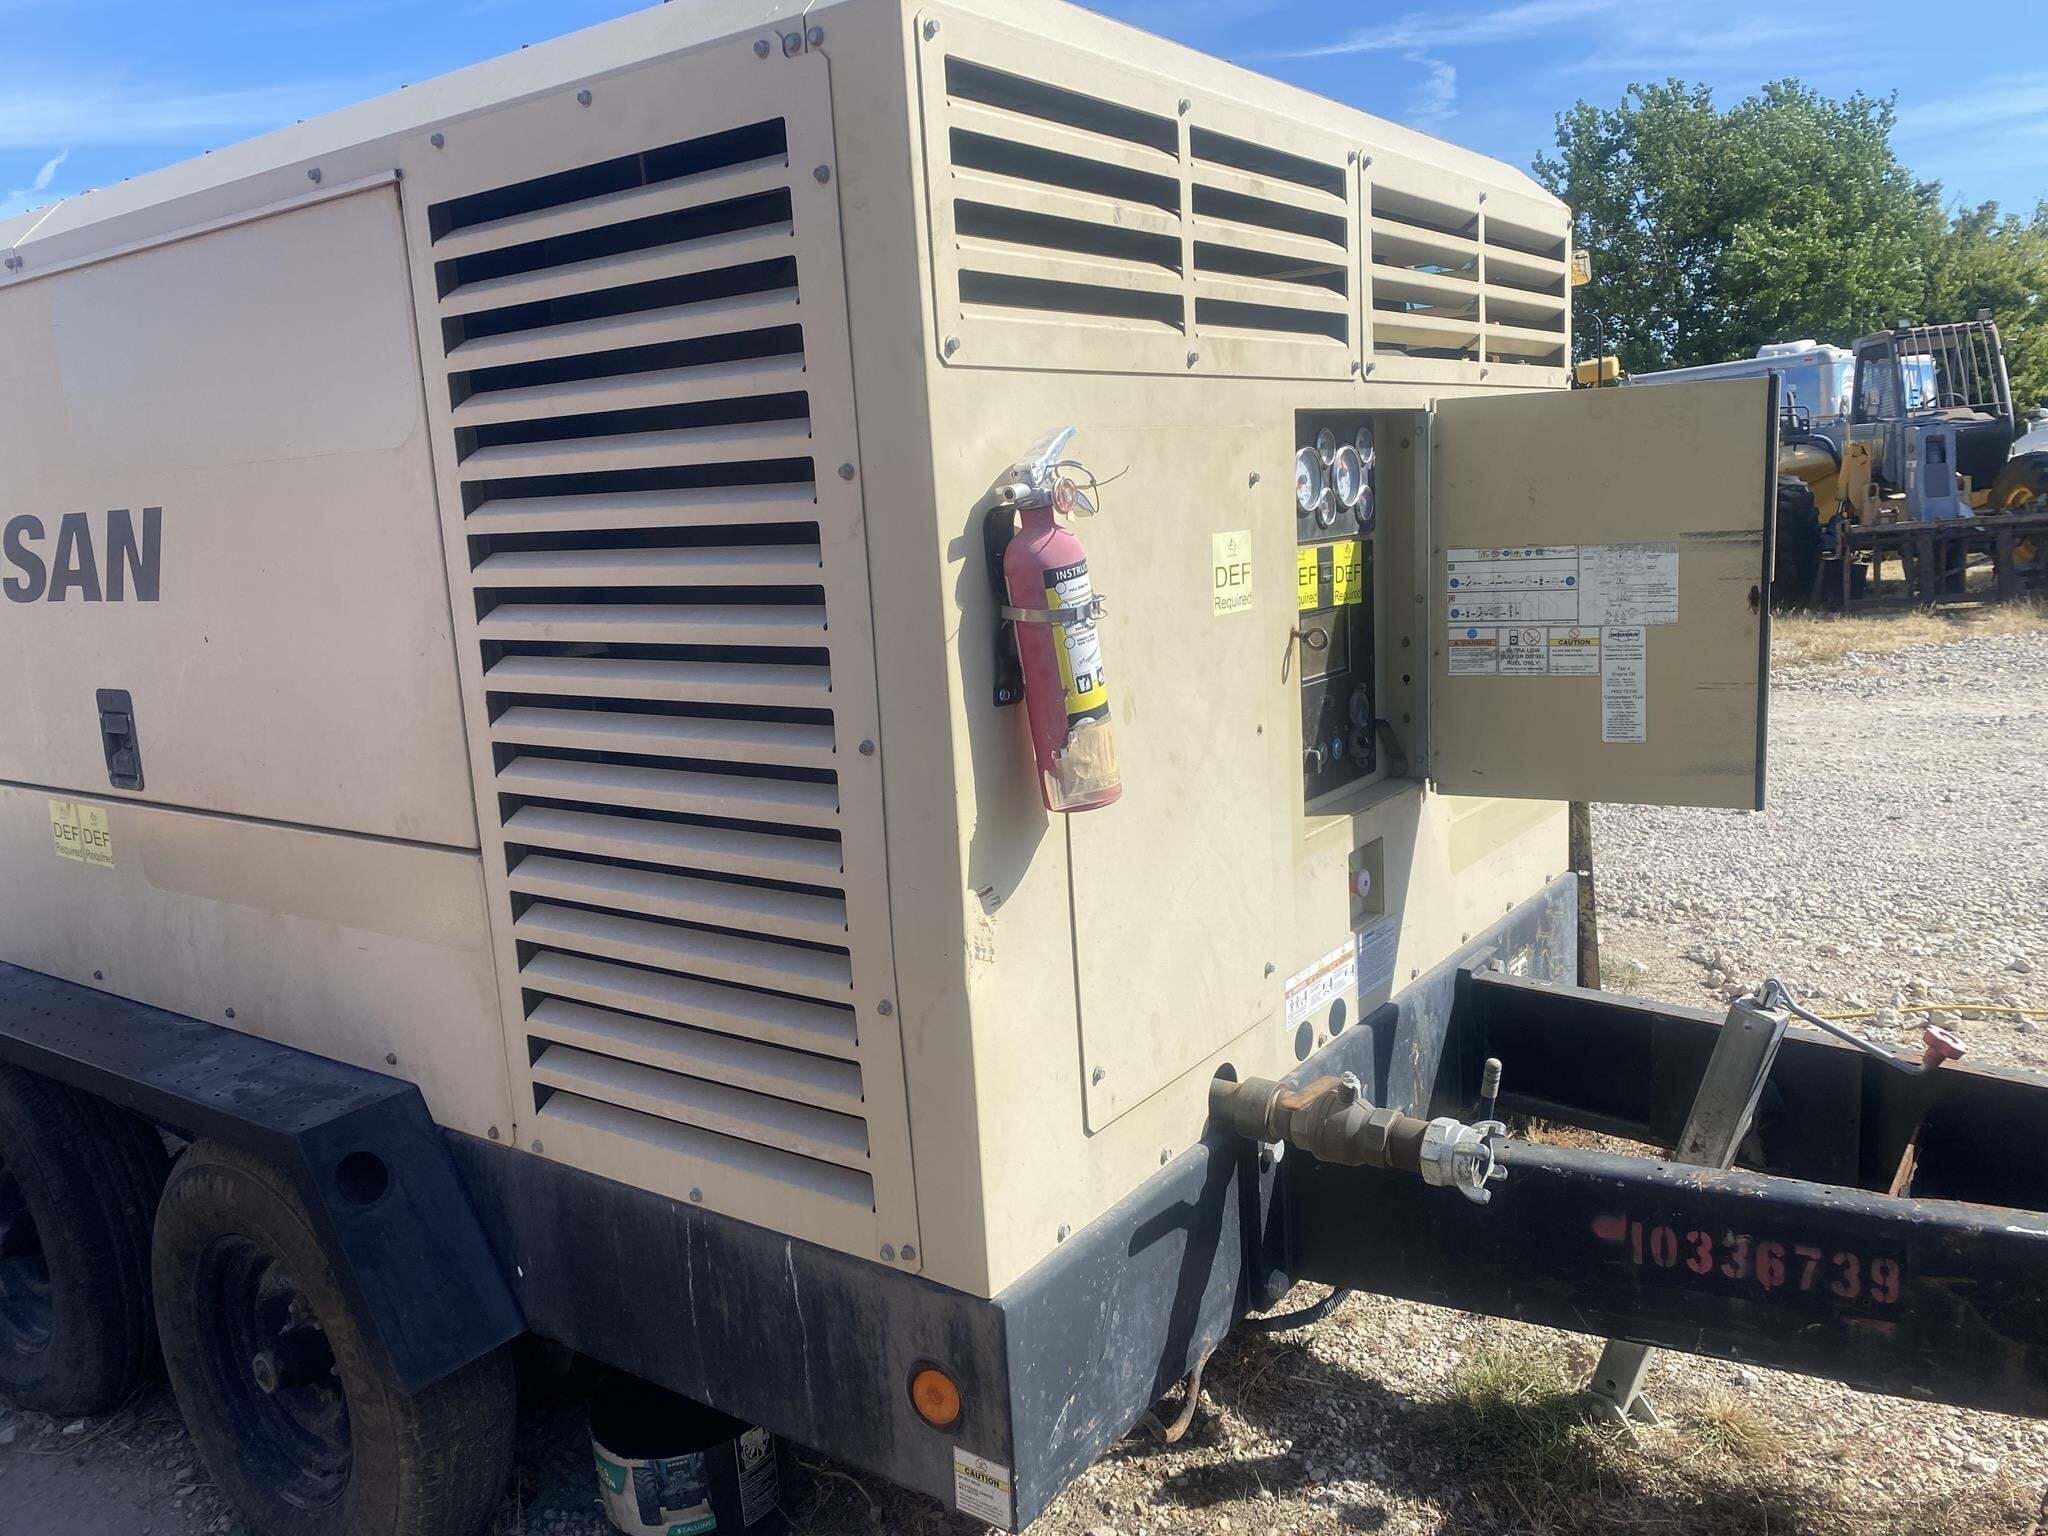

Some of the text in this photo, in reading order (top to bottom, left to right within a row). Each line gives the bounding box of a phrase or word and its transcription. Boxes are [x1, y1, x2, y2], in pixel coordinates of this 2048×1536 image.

[3, 506, 162, 602] SAN
[1215, 562, 1251, 588] DEF
[1298, 566, 1317, 585] EF
[1335, 564, 1361, 584] DEF
[1214, 592, 1252, 611] Required
[53, 822, 79, 840] DEF
[83, 828, 111, 848] DEF
[964, 1467, 1000, 1489] CAUTION
